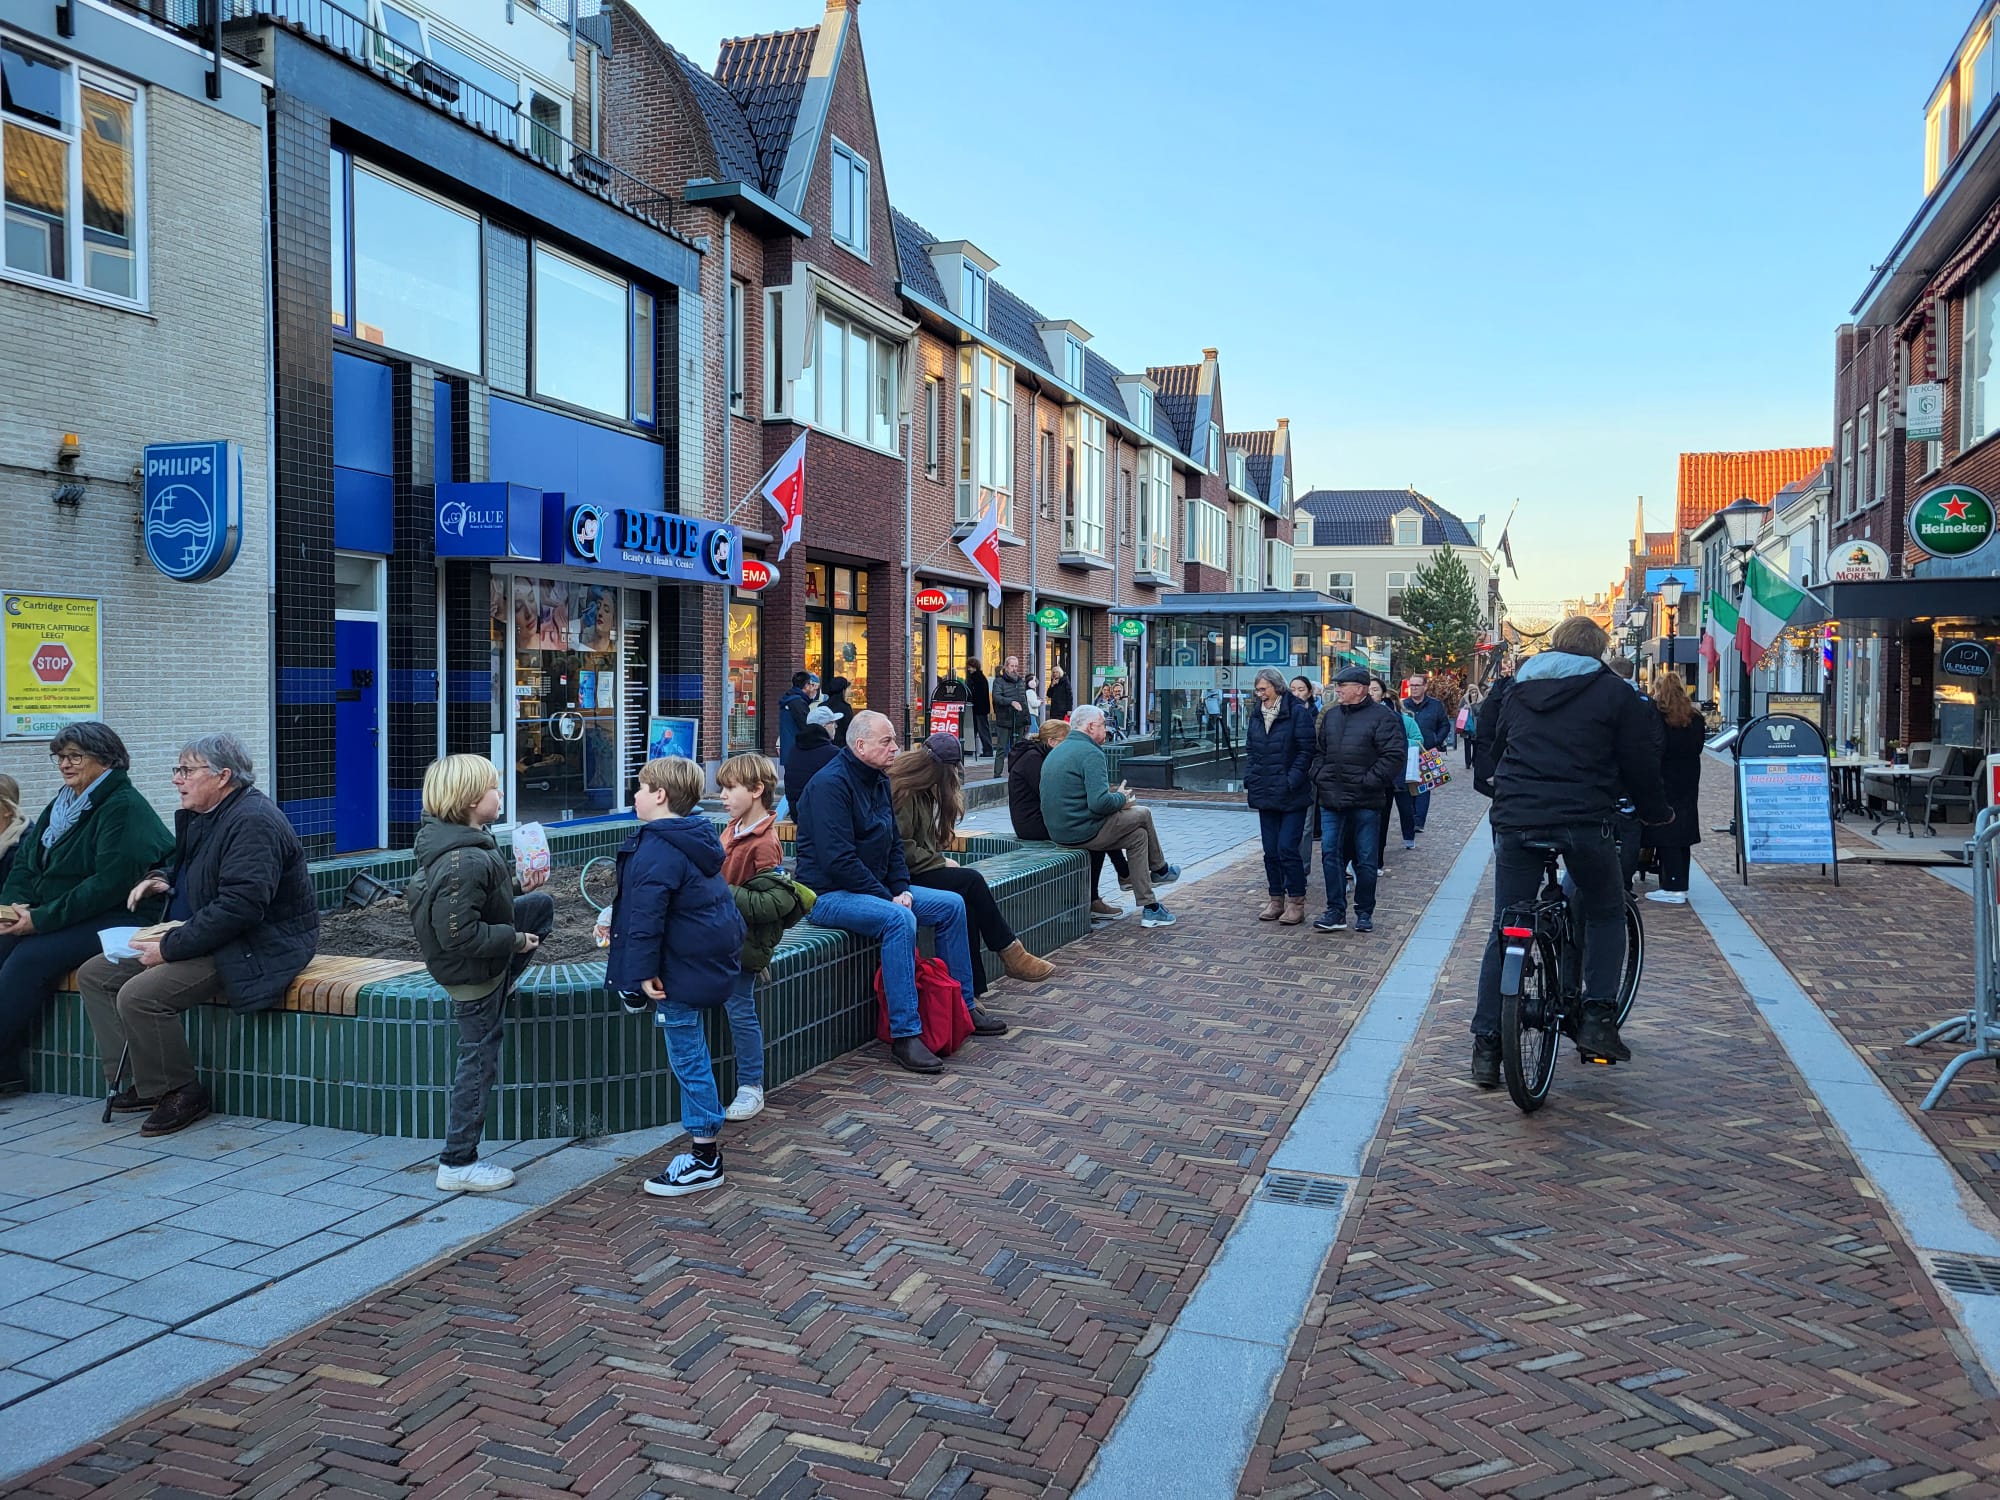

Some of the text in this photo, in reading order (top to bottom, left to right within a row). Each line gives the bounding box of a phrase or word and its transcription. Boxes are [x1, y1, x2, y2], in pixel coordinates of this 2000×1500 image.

[1922, 384, 1941, 393] KOO
[149, 457, 211, 477] PHILIPS
[469, 510, 504, 523] BLUE
[623, 508, 700, 558] BLUE
[1921, 522, 1987, 535] Heineken
[622, 551, 695, 569] Beauty & Health Center
[742, 569, 768, 583] EMA
[22, 601, 95, 612] Cartridge Corner
[916, 596, 945, 606] HEMA
[1040, 616, 1059, 624] Pearle
[12, 622, 91, 632] PRINTER CARTRIDGE
[41, 631, 65, 639] LEEG?
[1259, 638, 1277, 660] P
[37, 657, 69, 670] STOP
[33, 721, 72, 732] GREENW
[930, 719, 959, 733] sale
[1766, 724, 1795, 741] W
